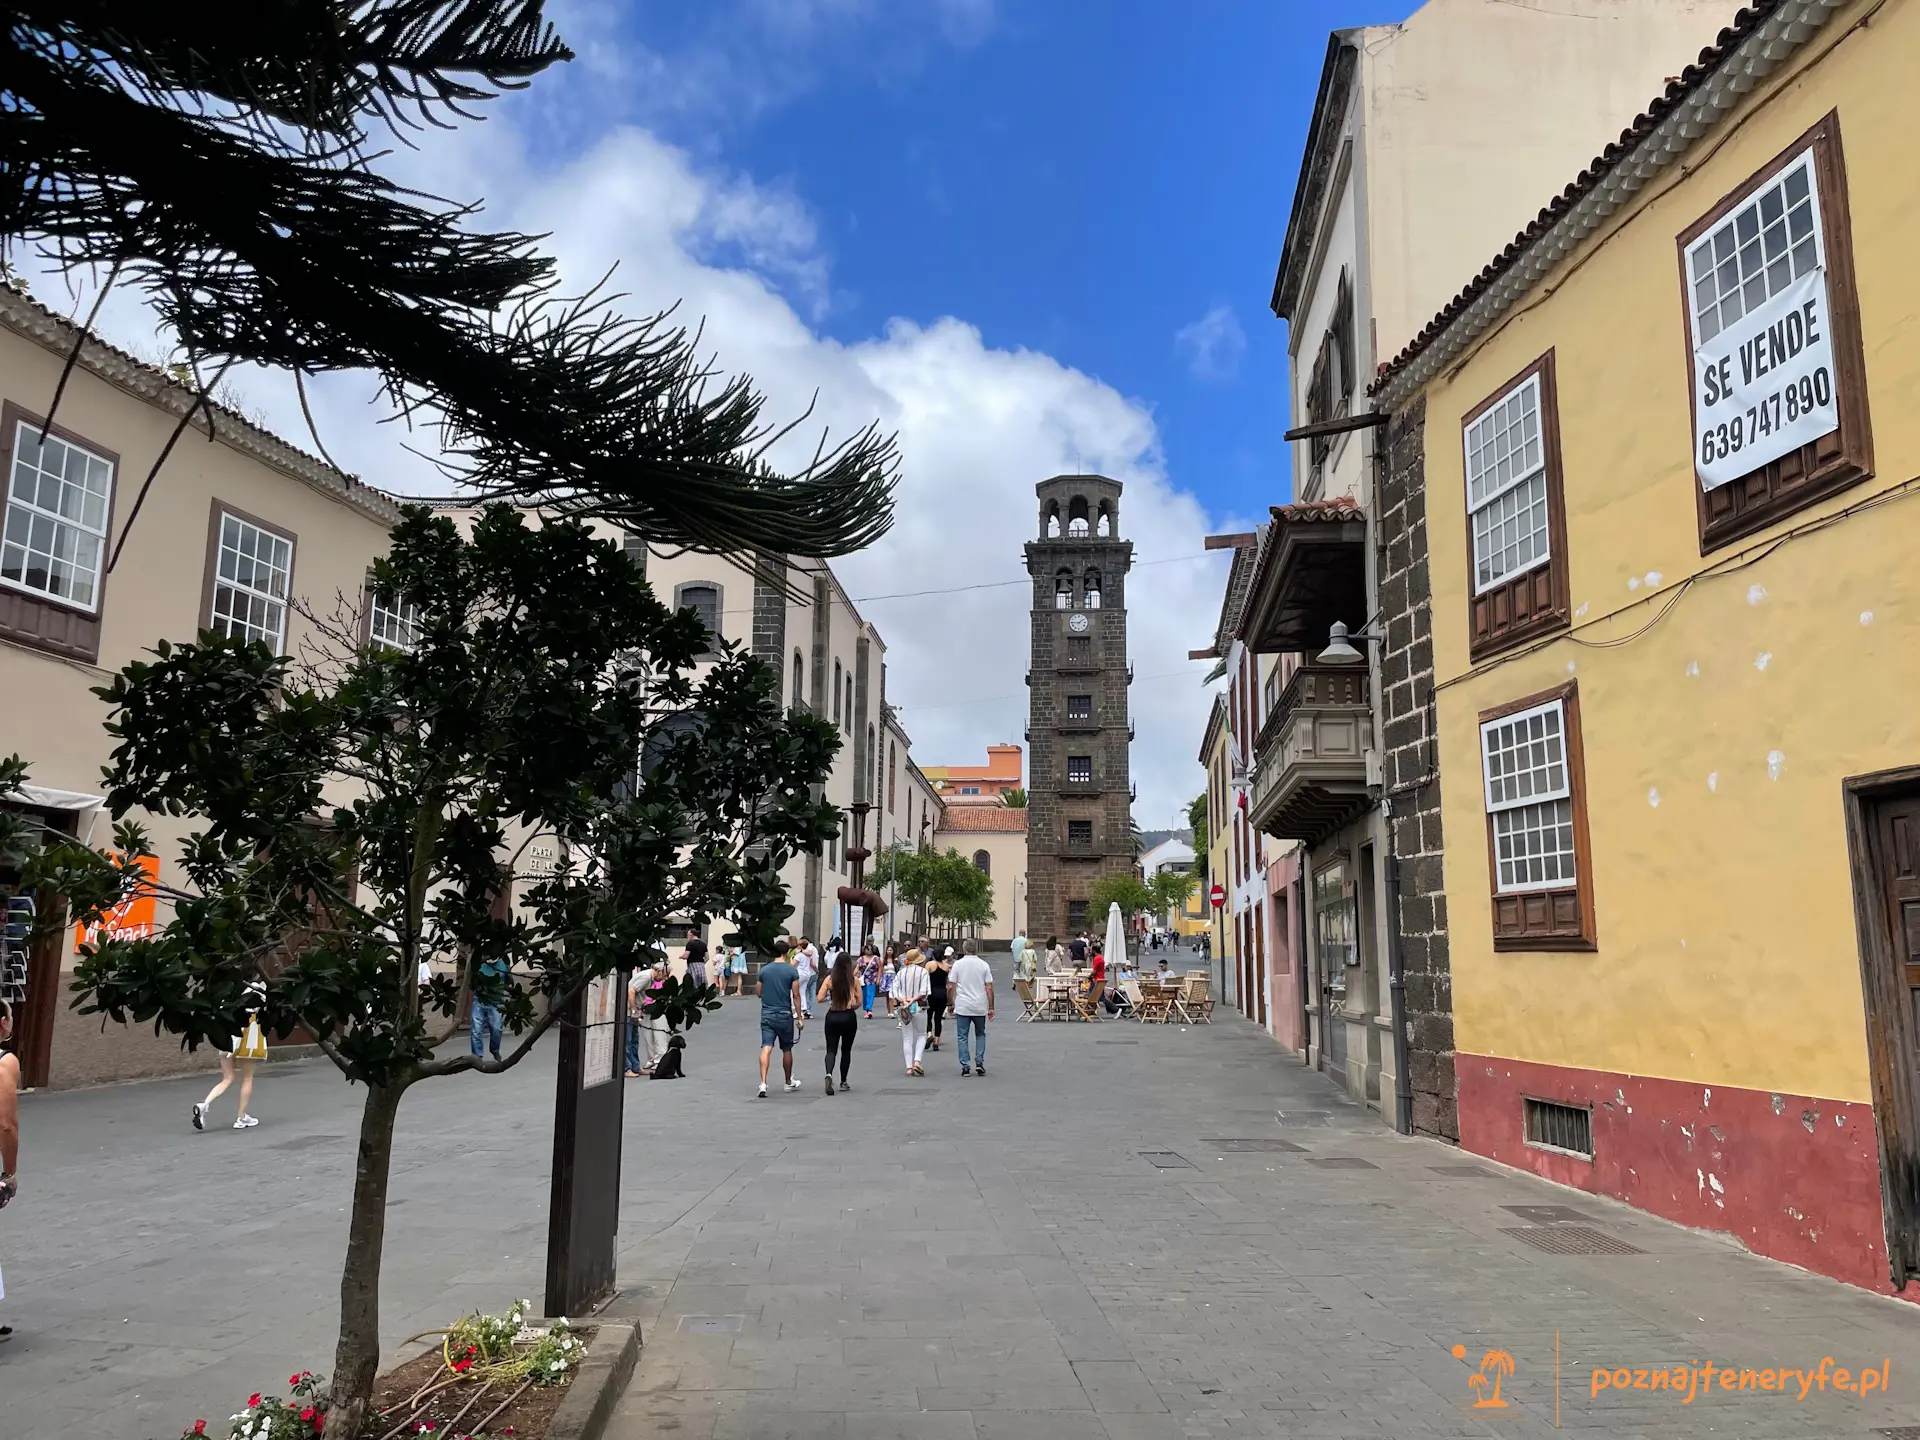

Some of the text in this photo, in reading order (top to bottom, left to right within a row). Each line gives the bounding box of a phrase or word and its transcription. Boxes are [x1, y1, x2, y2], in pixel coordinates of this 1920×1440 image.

[1703, 297, 1820, 408] SE VENDE
[1701, 366, 1831, 466] 639.747.890
[531, 860, 552, 870] DE LA
[532, 846, 553, 857] PLAZA
